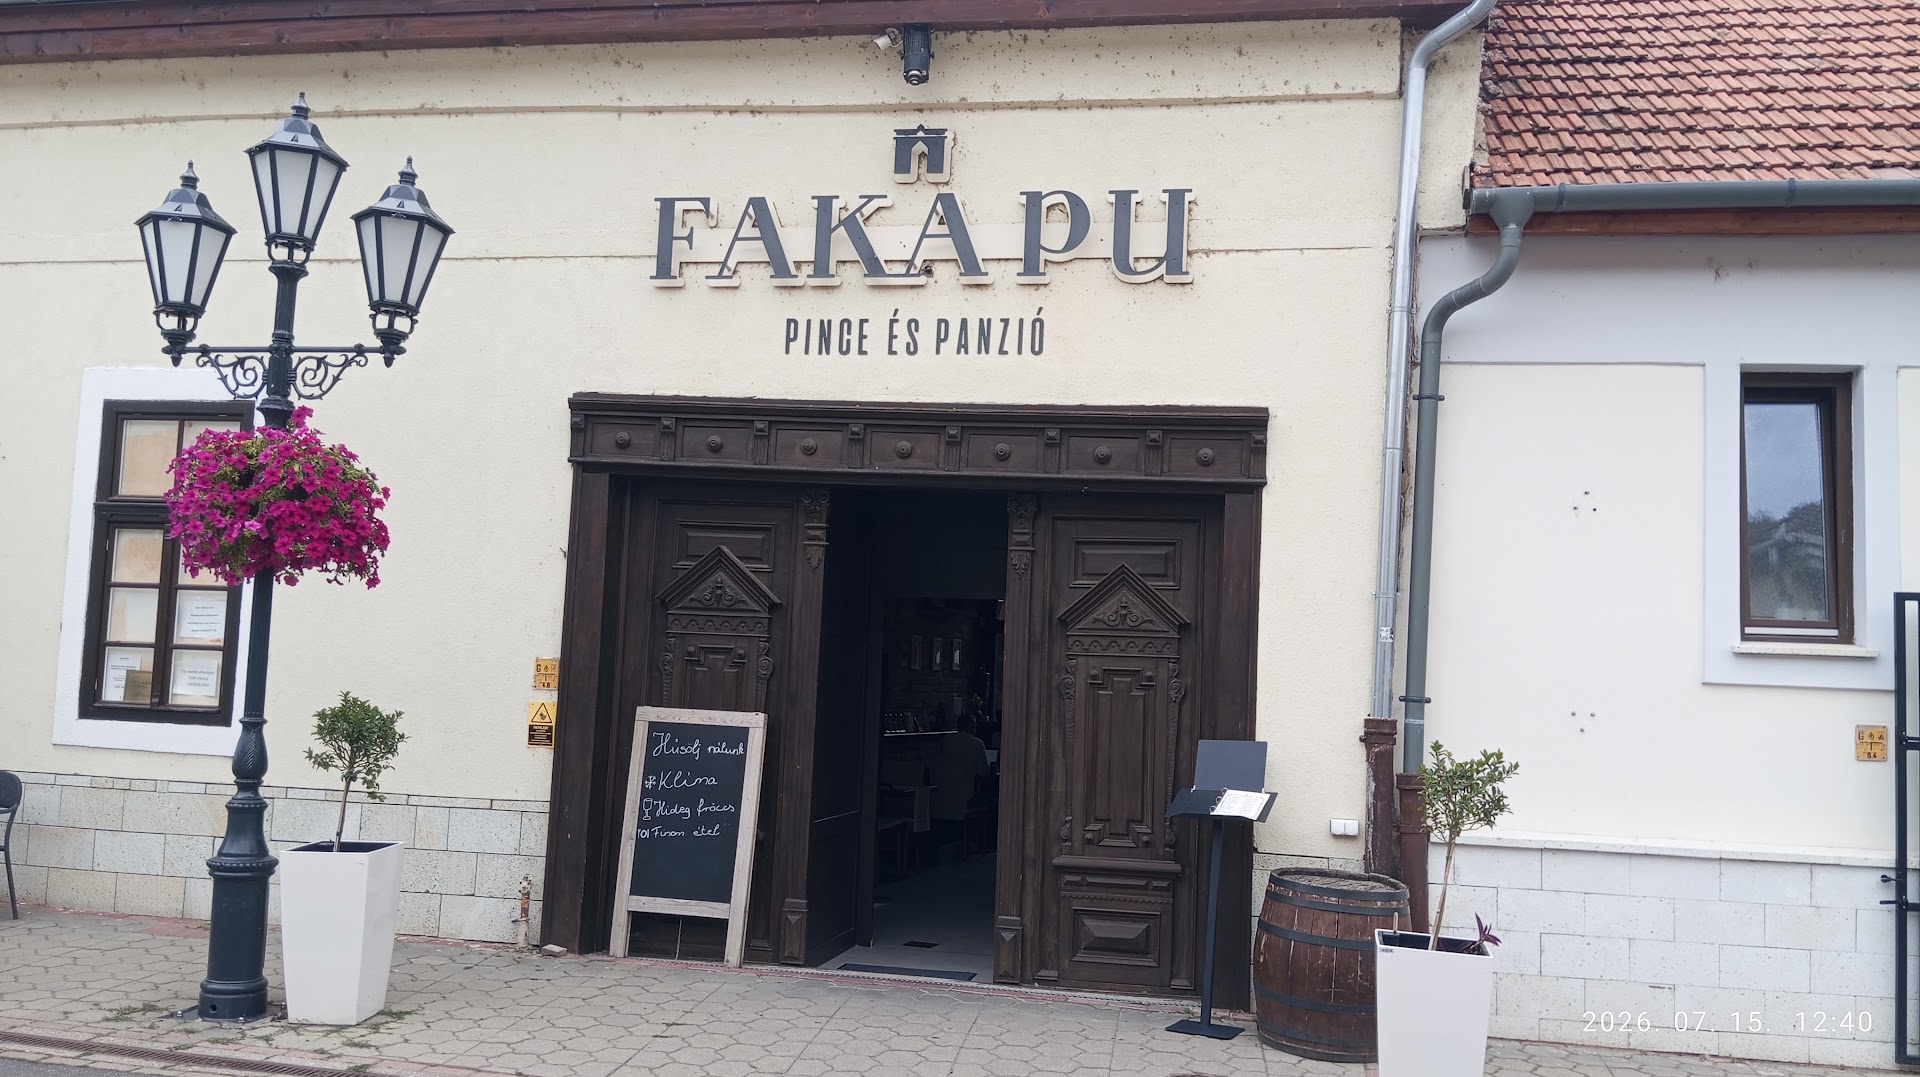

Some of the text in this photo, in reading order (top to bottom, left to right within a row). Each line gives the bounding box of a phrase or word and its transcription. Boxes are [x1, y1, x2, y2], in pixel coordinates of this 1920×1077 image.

[784, 306, 1046, 356] PINCE ÉS PANZIÓ
[707, 741, 745, 756] nálunk
[658, 770, 718, 791] Klíma
[653, 800, 691, 820] Hideg
[651, 823, 721, 838] Finom étel
